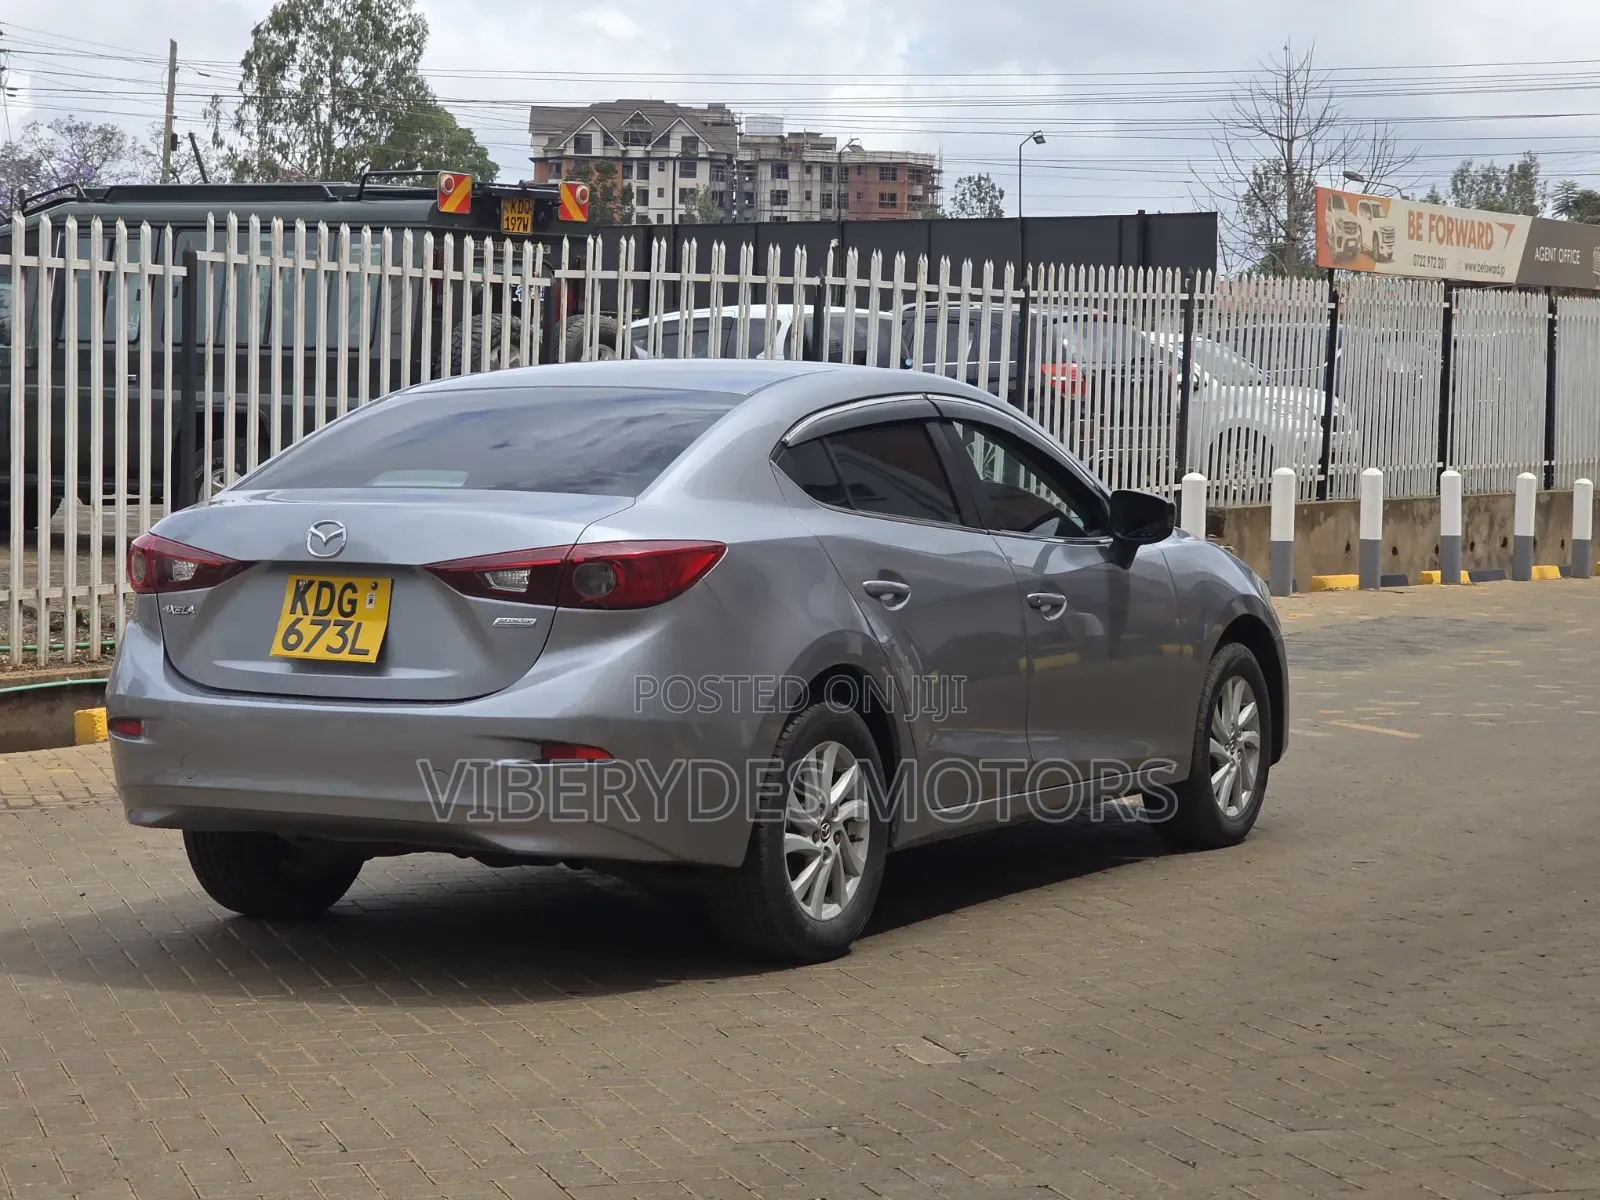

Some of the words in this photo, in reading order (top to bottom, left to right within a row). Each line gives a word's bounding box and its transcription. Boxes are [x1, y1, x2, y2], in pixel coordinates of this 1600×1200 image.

[504, 215, 530, 232] 197W
[1407, 209, 1424, 242] BE
[1428, 213, 1494, 251] FORWARD
[1412, 253, 1426, 268] 0722
[1427, 255, 1437, 269] 972
[1437, 256, 1447, 270] 201
[1533, 246, 1557, 262] AGENT
[1558, 247, 1581, 265] OFFICE
[289, 579, 359, 619] KDG
[281, 617, 371, 656] 673L
